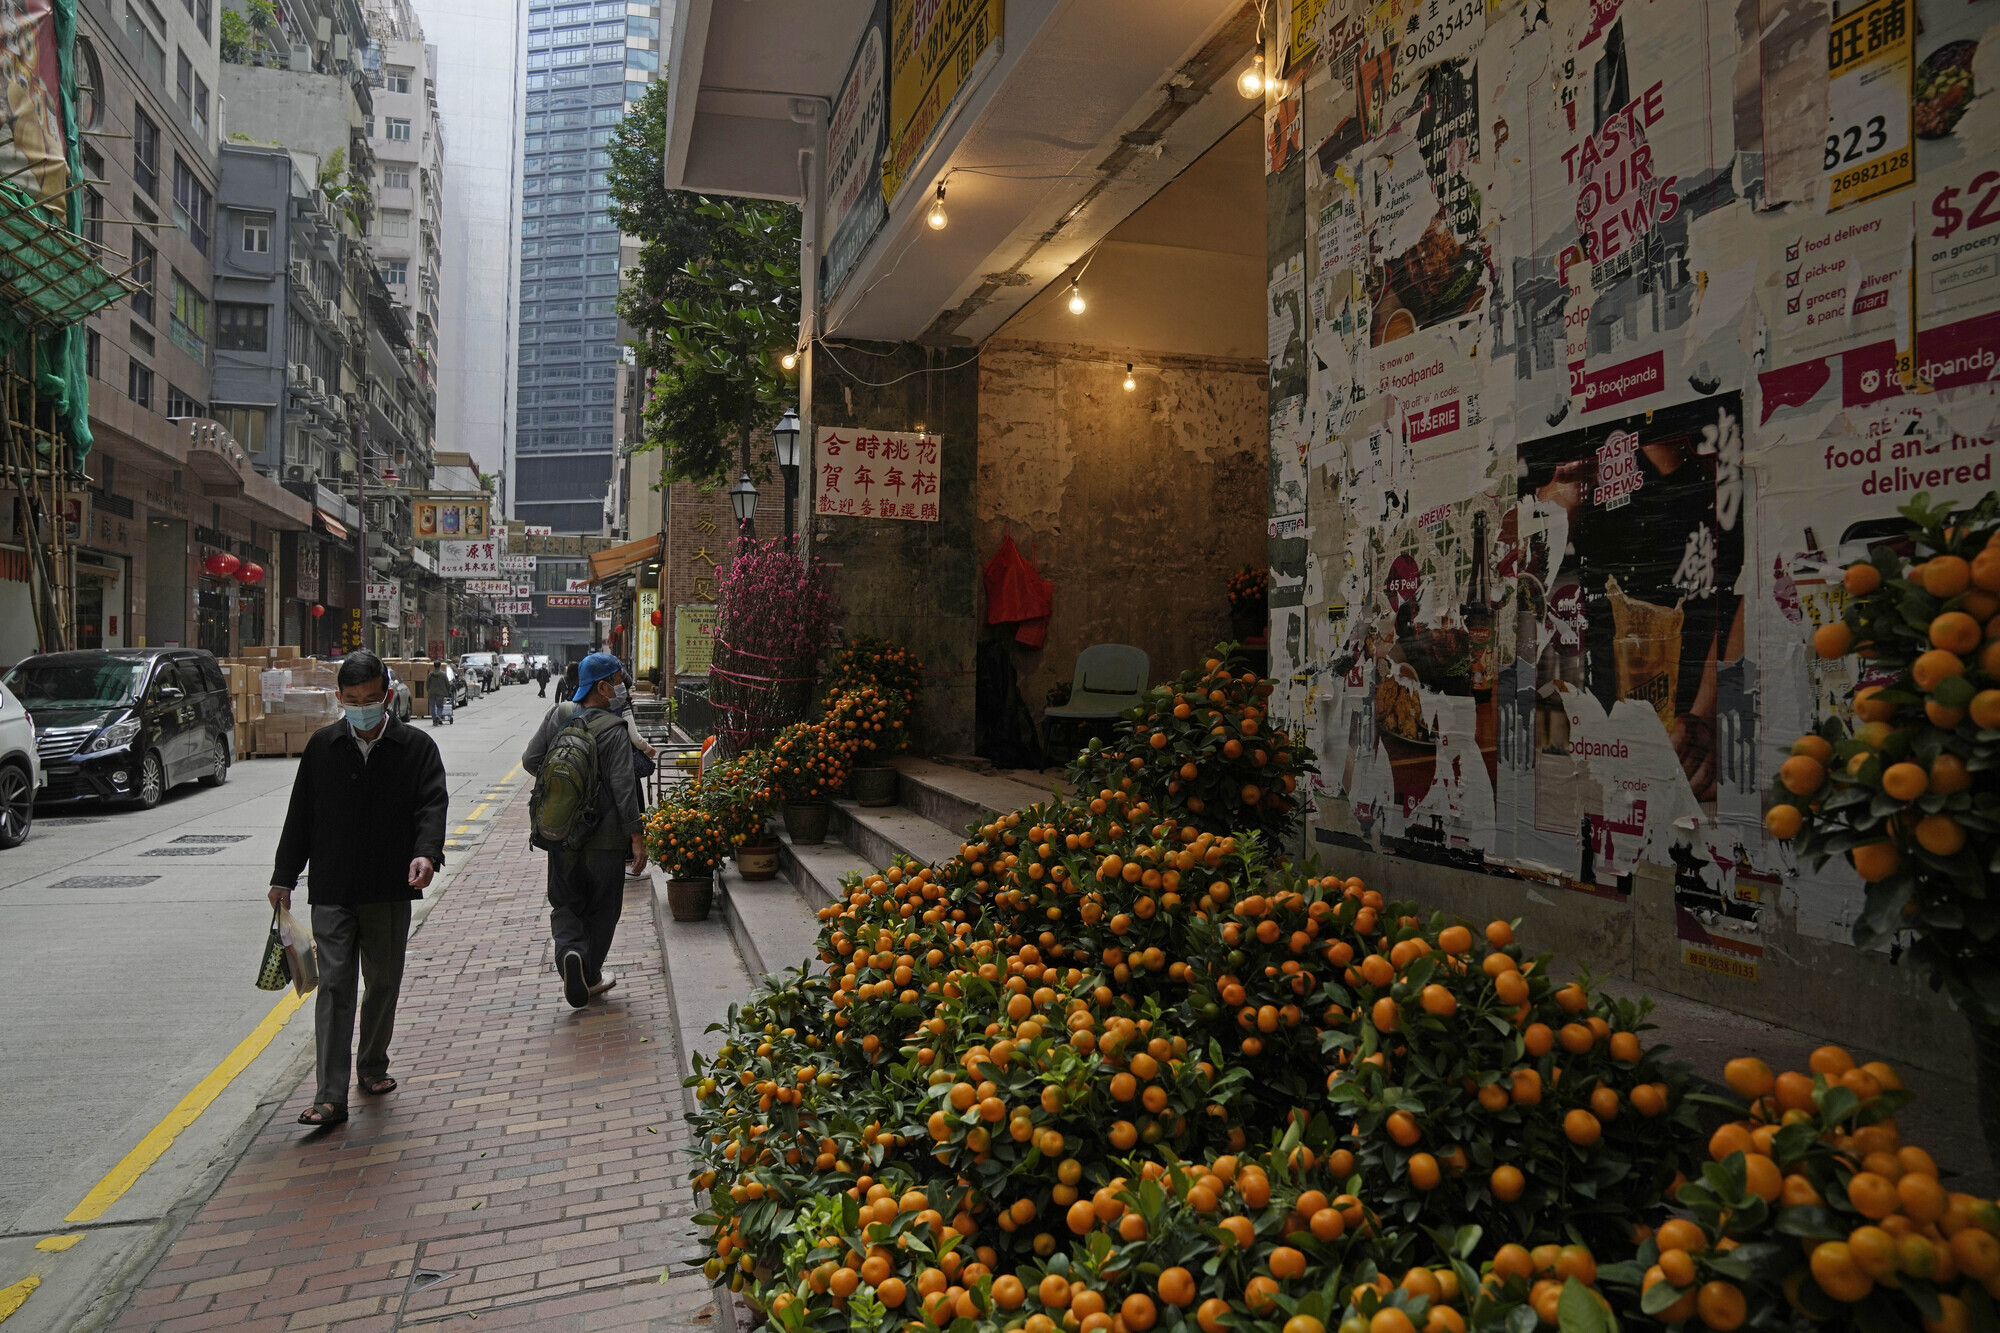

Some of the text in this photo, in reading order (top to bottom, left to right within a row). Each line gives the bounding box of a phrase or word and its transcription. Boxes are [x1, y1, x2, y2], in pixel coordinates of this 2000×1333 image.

[1405, 0, 1484, 66] 96835434
[1829, 3, 1905, 68] 旺舖
[1560, 80, 1664, 186] TASTE
[1576, 144, 1653, 224] OUR
[1833, 152, 1910, 194] 26982128
[1804, 218, 1882, 253] food delivery
[1931, 234, 2000, 261] on grocery
[1804, 258, 1846, 282] pick-up
[1938, 264, 1989, 285] with code
[1379, 351, 1415, 372] is now on
[1391, 359, 1444, 388] foodpanda
[1598, 366, 1657, 394] foodpanda
[822, 432, 938, 464] 合時桃花
[1596, 432, 1639, 465] TASTE
[1825, 438, 1881, 470] food
[820, 463, 938, 497] 賀年年桔
[1602, 457, 1633, 481] OUR
[1862, 453, 1991, 496] delivered
[1594, 472, 1644, 505] BREWS
[819, 494, 938, 521] 歡迎參觀選購
[1418, 504, 1451, 528] BREWS
[1389, 577, 1418, 592] 65 Peel
